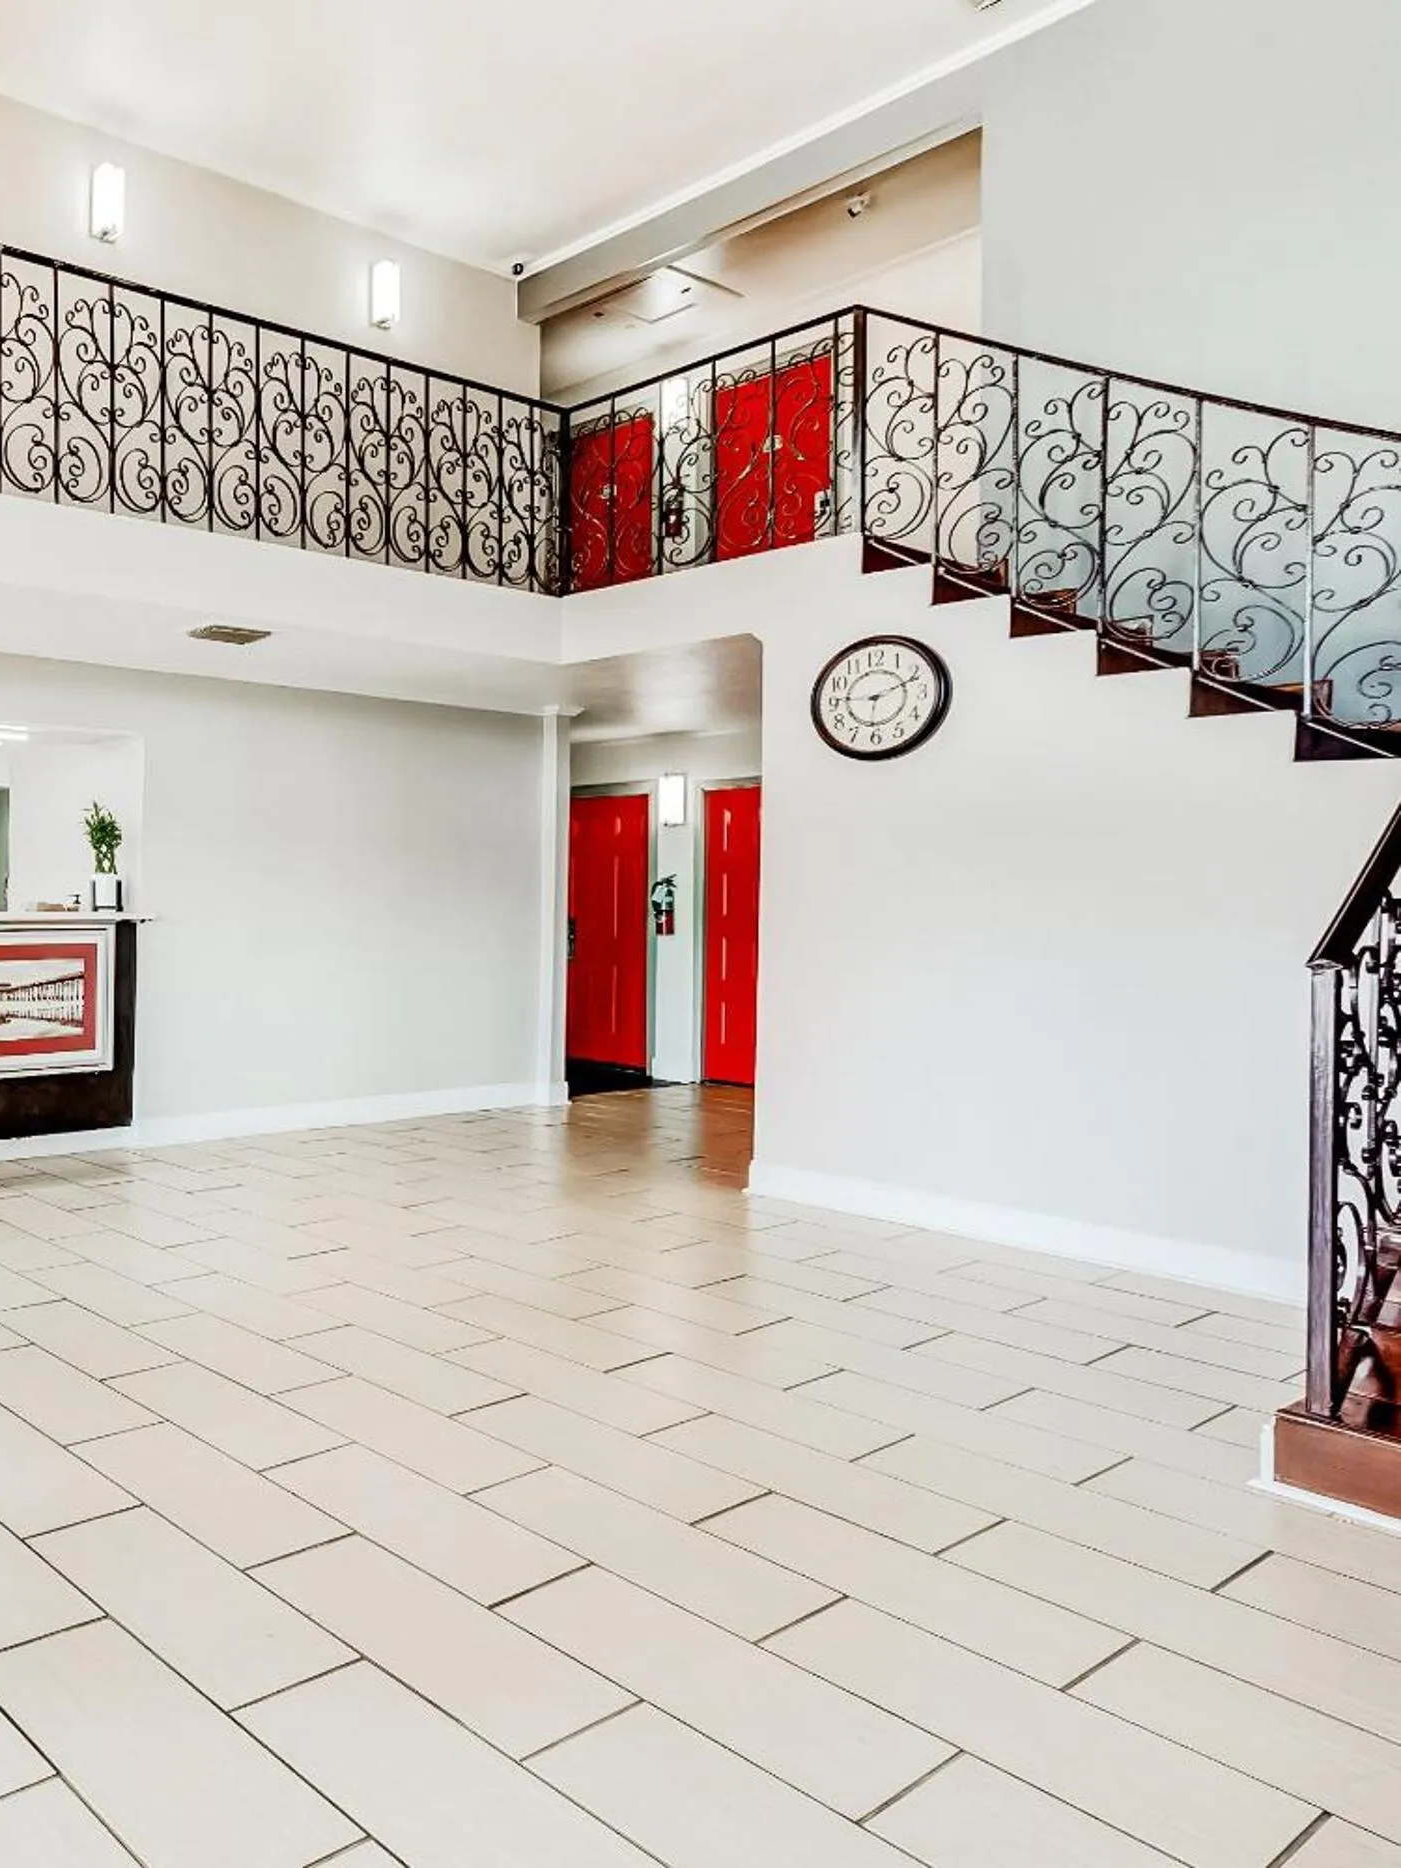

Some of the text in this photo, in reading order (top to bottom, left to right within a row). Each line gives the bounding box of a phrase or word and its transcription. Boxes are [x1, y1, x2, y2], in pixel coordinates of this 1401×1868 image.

[847, 658, 861, 675] 11
[867, 649, 885, 668] 12
[832, 675, 848, 692] 10
[917, 683, 928, 700] 3
[907, 704, 921, 721] 4
[833, 712, 845, 731] 8
[892, 720, 905, 739] 5
[848, 726, 860, 743] 7
[869, 728, 883, 745] 6
